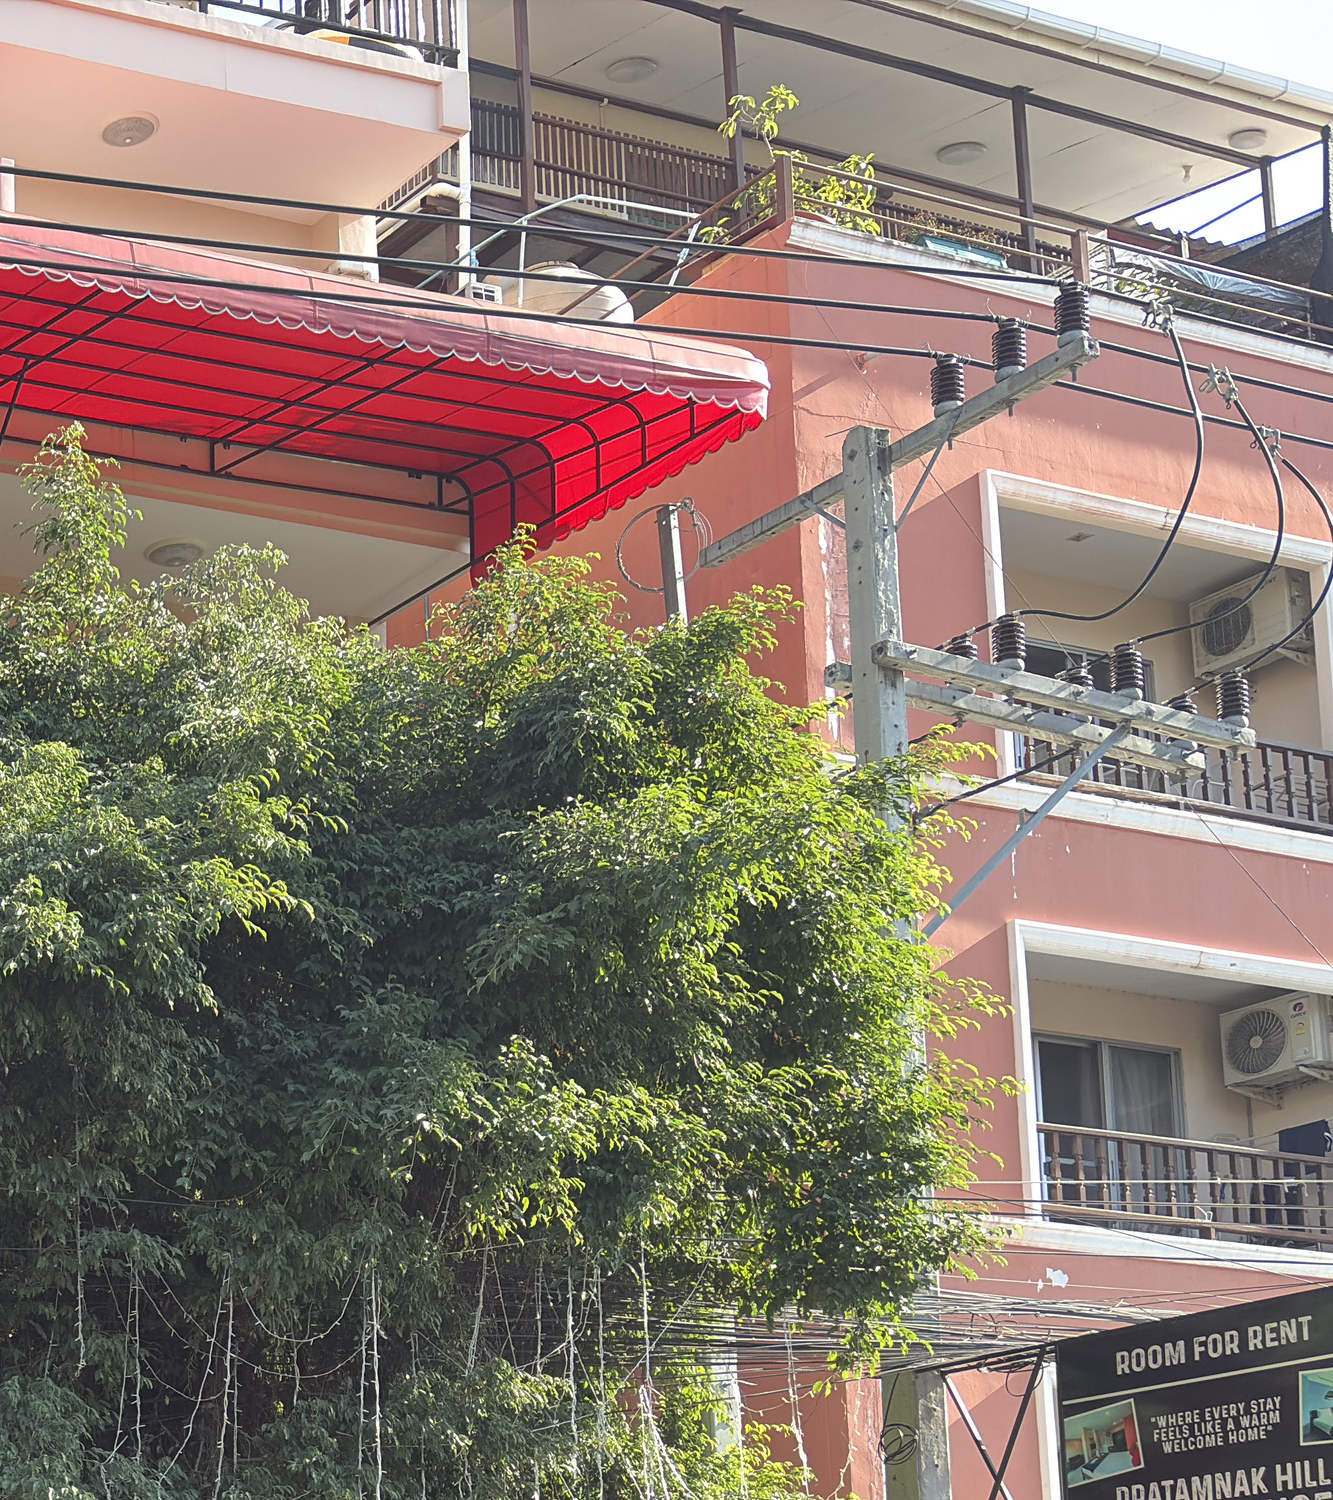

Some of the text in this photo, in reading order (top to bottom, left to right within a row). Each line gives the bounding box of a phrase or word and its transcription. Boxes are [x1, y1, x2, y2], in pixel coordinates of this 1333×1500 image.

[1115, 1316, 1313, 1375] ROOM FOR RENT
[1205, 1402, 1245, 1421] EVERY
[1250, 1396, 1281, 1413] STAY
[1153, 1411, 1280, 1442] FEELS LIKE A WARM
[1162, 1433, 1224, 1454] WELCOME
[1275, 1458, 1332, 1492] HILL
